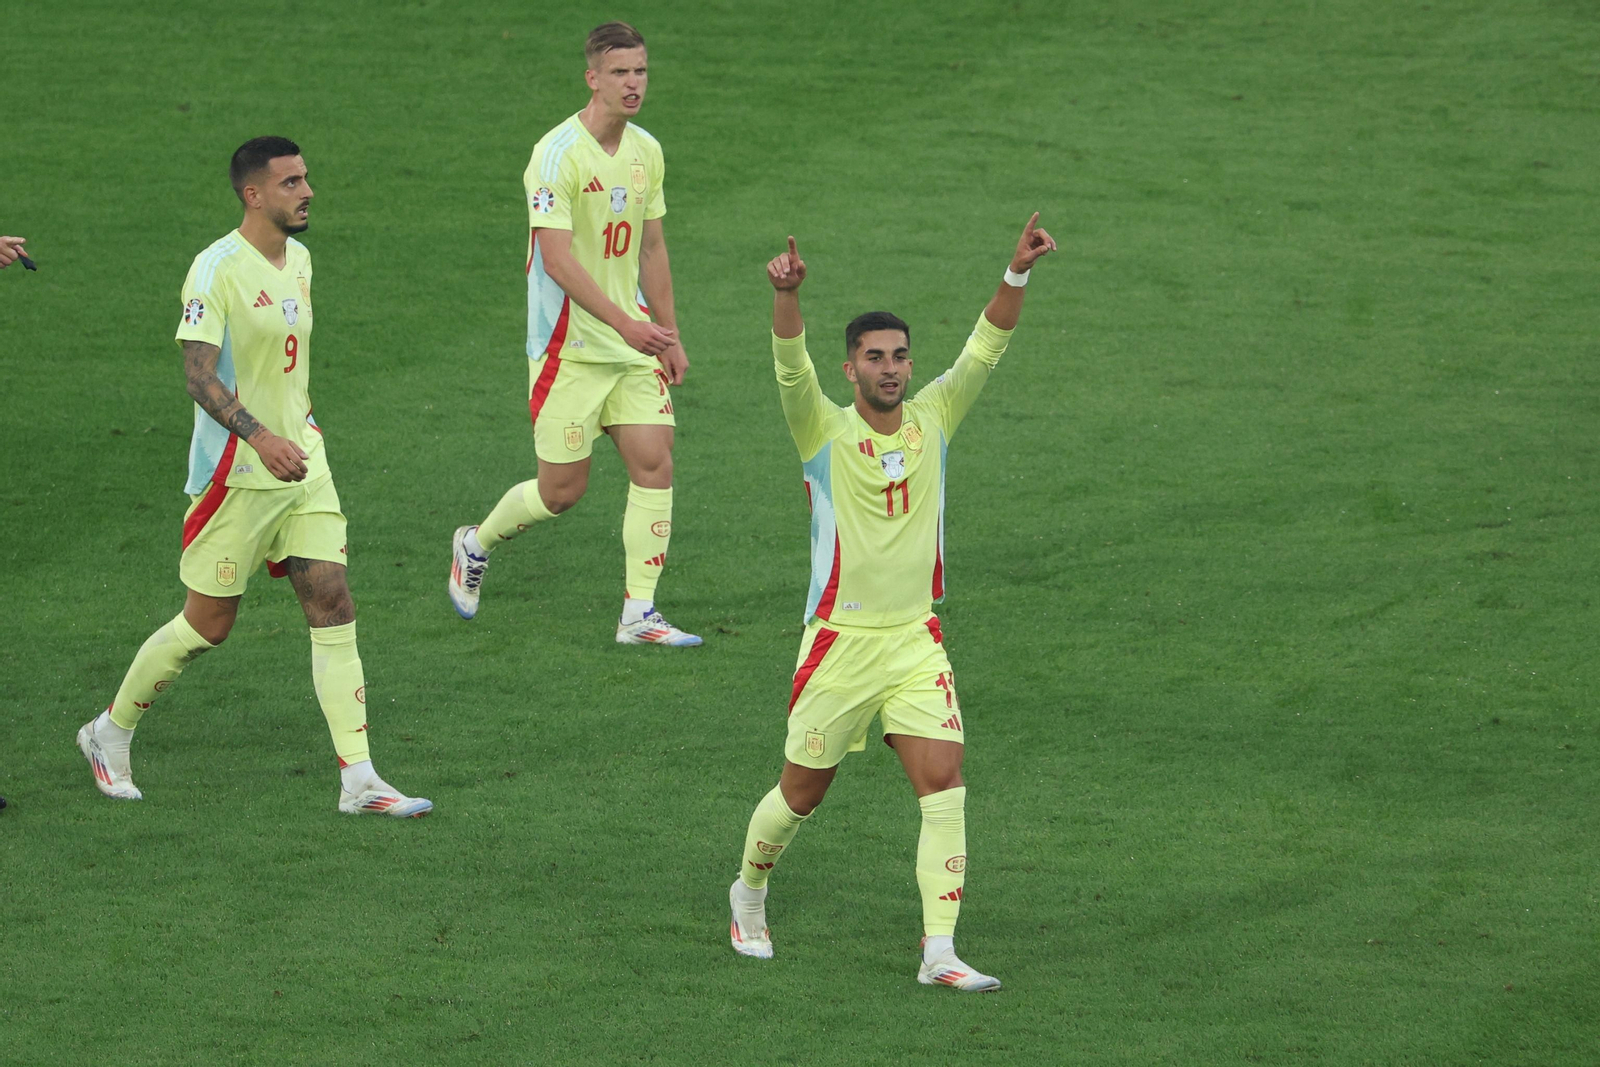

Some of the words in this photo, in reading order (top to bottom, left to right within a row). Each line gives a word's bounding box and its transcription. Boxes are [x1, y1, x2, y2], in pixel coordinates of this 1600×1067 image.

[602, 220, 632, 259] 10
[283, 334, 298, 374] 9
[880, 477, 909, 517] 11
